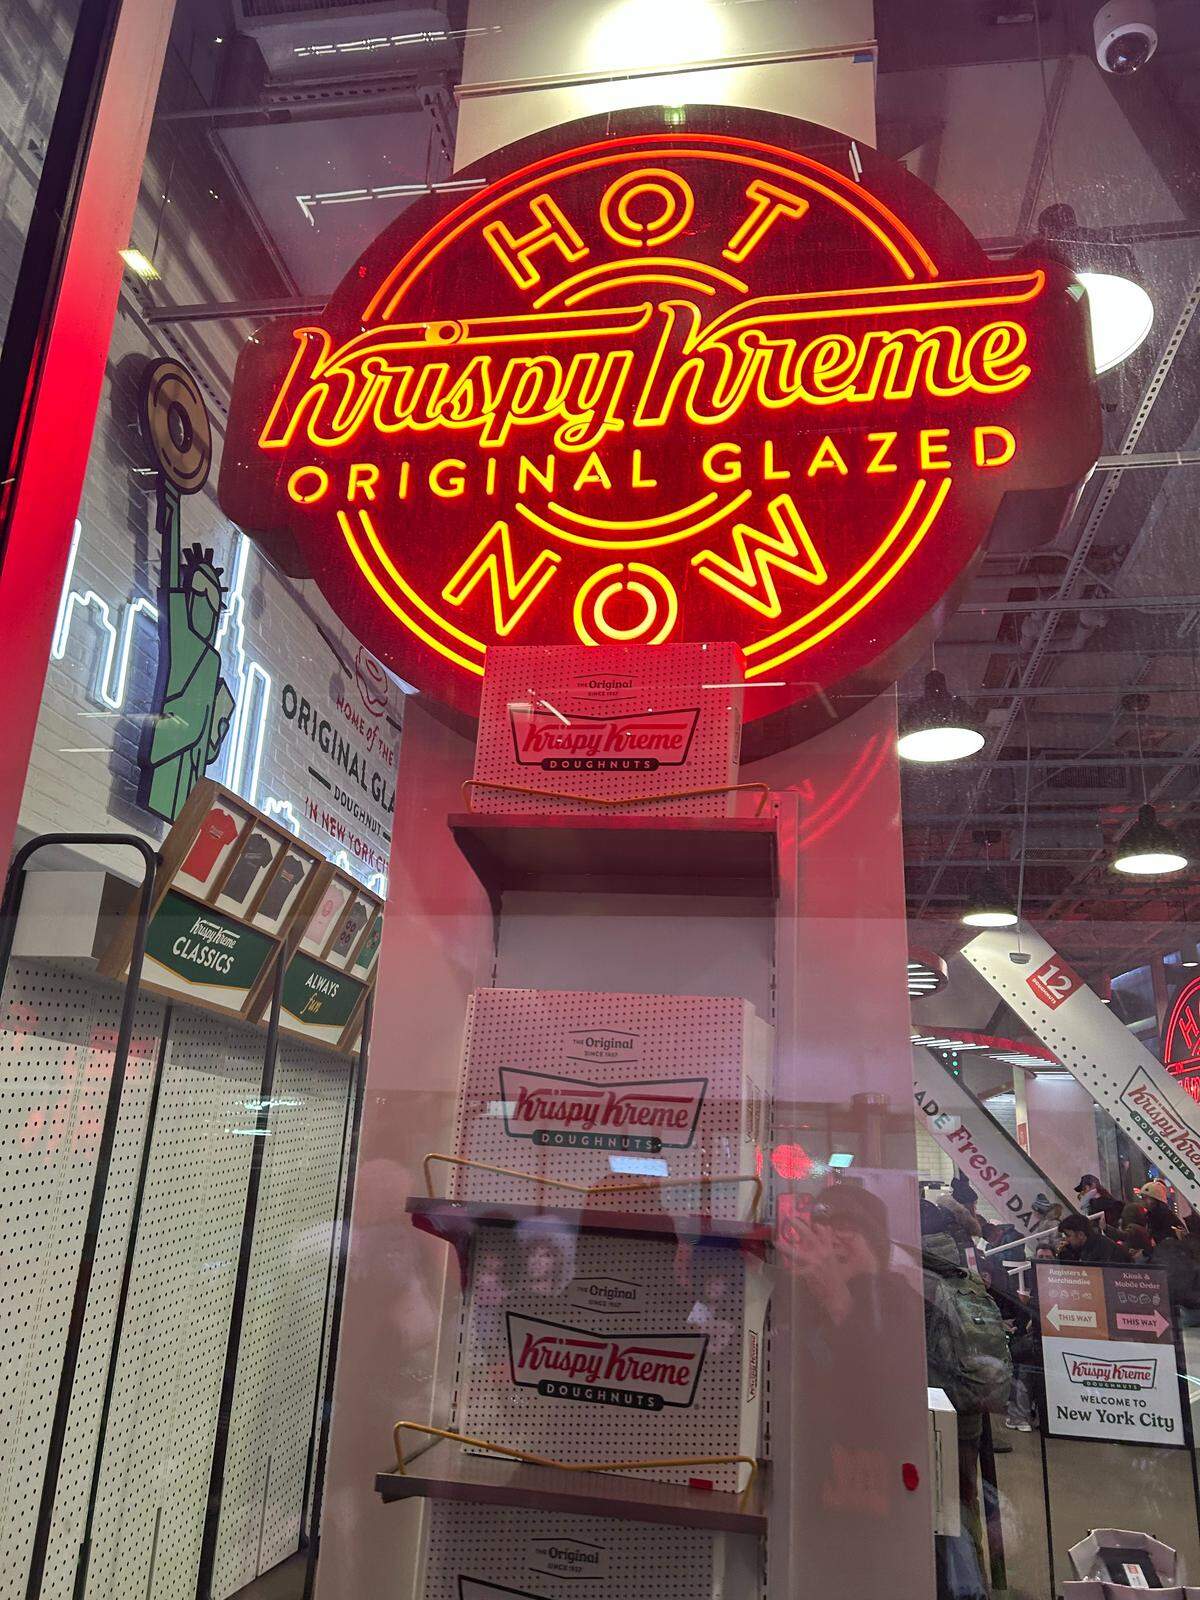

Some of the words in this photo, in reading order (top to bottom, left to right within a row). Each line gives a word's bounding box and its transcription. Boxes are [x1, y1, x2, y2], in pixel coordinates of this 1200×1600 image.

[483, 168, 809, 290] HOT
[258, 302, 653, 453] Krispy
[633, 270, 1046, 428] Kreme
[287, 448, 658, 504] ORIGINAL
[701, 425, 1017, 485] GLAZED
[441, 493, 828, 646] NOW
[588, 680, 633, 691] Original
[281, 683, 368, 793] ORIGINAL
[336, 693, 365, 737] HOME
[365, 724, 379, 753] of
[378, 743, 394, 767] THE
[522, 723, 607, 757] Krispy
[602, 723, 688, 752] Kreme
[550, 759, 652, 769] DOUGHNUTS
[333, 785, 382, 837] DOUGHNUT
[304, 796, 318, 823] IN
[321, 809, 346, 843] NEW
[348, 831, 375, 868] YORK
[375, 855, 389, 875] CI
[189, 916, 220, 945] Krispy
[211, 926, 241, 949] Kreme
[172, 936, 235, 975] CLASSICS
[304, 972, 340, 998] ALWAYS
[1037, 964, 1072, 1000] 12
[300, 992, 323, 1015] fun
[585, 1037, 634, 1051] Original
[512, 1085, 606, 1129] Krispy
[600, 1090, 695, 1129] Kreme
[1127, 1083, 1186, 1138] Krispy
[541, 1132, 654, 1150] DOUGHNUTS
[914, 1082, 951, 1131] ADE
[946, 1124, 1011, 1197] Fresh
[1133, 1114, 1192, 1176] DOUGHNUTS
[589, 1284, 636, 1300] Original
[1140, 1281, 1160, 1290] Order
[1058, 1313, 1075, 1322] THIS
[1077, 1314, 1093, 1322] WAY
[1121, 1317, 1139, 1326] THIS
[1141, 1319, 1157, 1327] WAY
[518, 1333, 608, 1379] Krispy
[603, 1342, 696, 1387] Kreme
[1072, 1361, 1112, 1382] Krispy
[1112, 1364, 1152, 1381] Kreme
[546, 1382, 657, 1408] DOUGHNUTS
[1080, 1394, 1131, 1407] WELCOME
[1131, 1399, 1147, 1408] TO
[1086, 1381, 1138, 1390] DOUGHNUTS
[1056, 1405, 1092, 1421] New
[1095, 1409, 1136, 1426] York
[1140, 1412, 1175, 1432] City
[549, 1547, 599, 1564] Original
